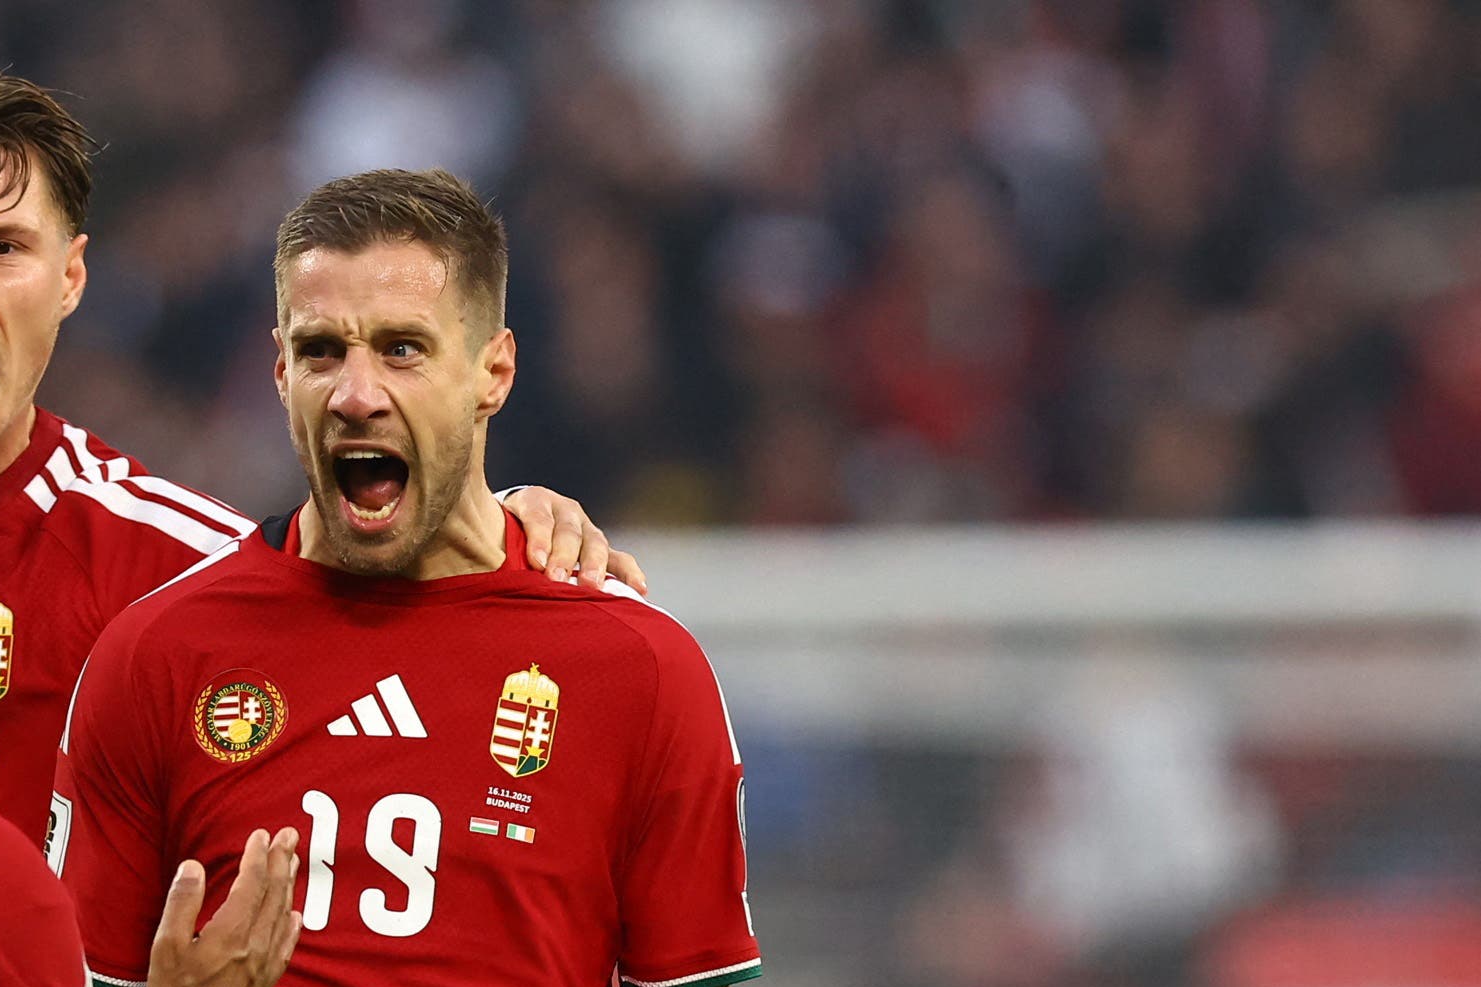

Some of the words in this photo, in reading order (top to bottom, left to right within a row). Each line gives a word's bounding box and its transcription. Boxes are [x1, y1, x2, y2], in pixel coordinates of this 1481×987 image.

[230, 743, 251, 751] 1901
[229, 751, 251, 763] 125
[488, 786, 532, 803] 16.11.2025
[486, 797, 530, 813] BUDAPEST
[302, 789, 442, 937] 19
